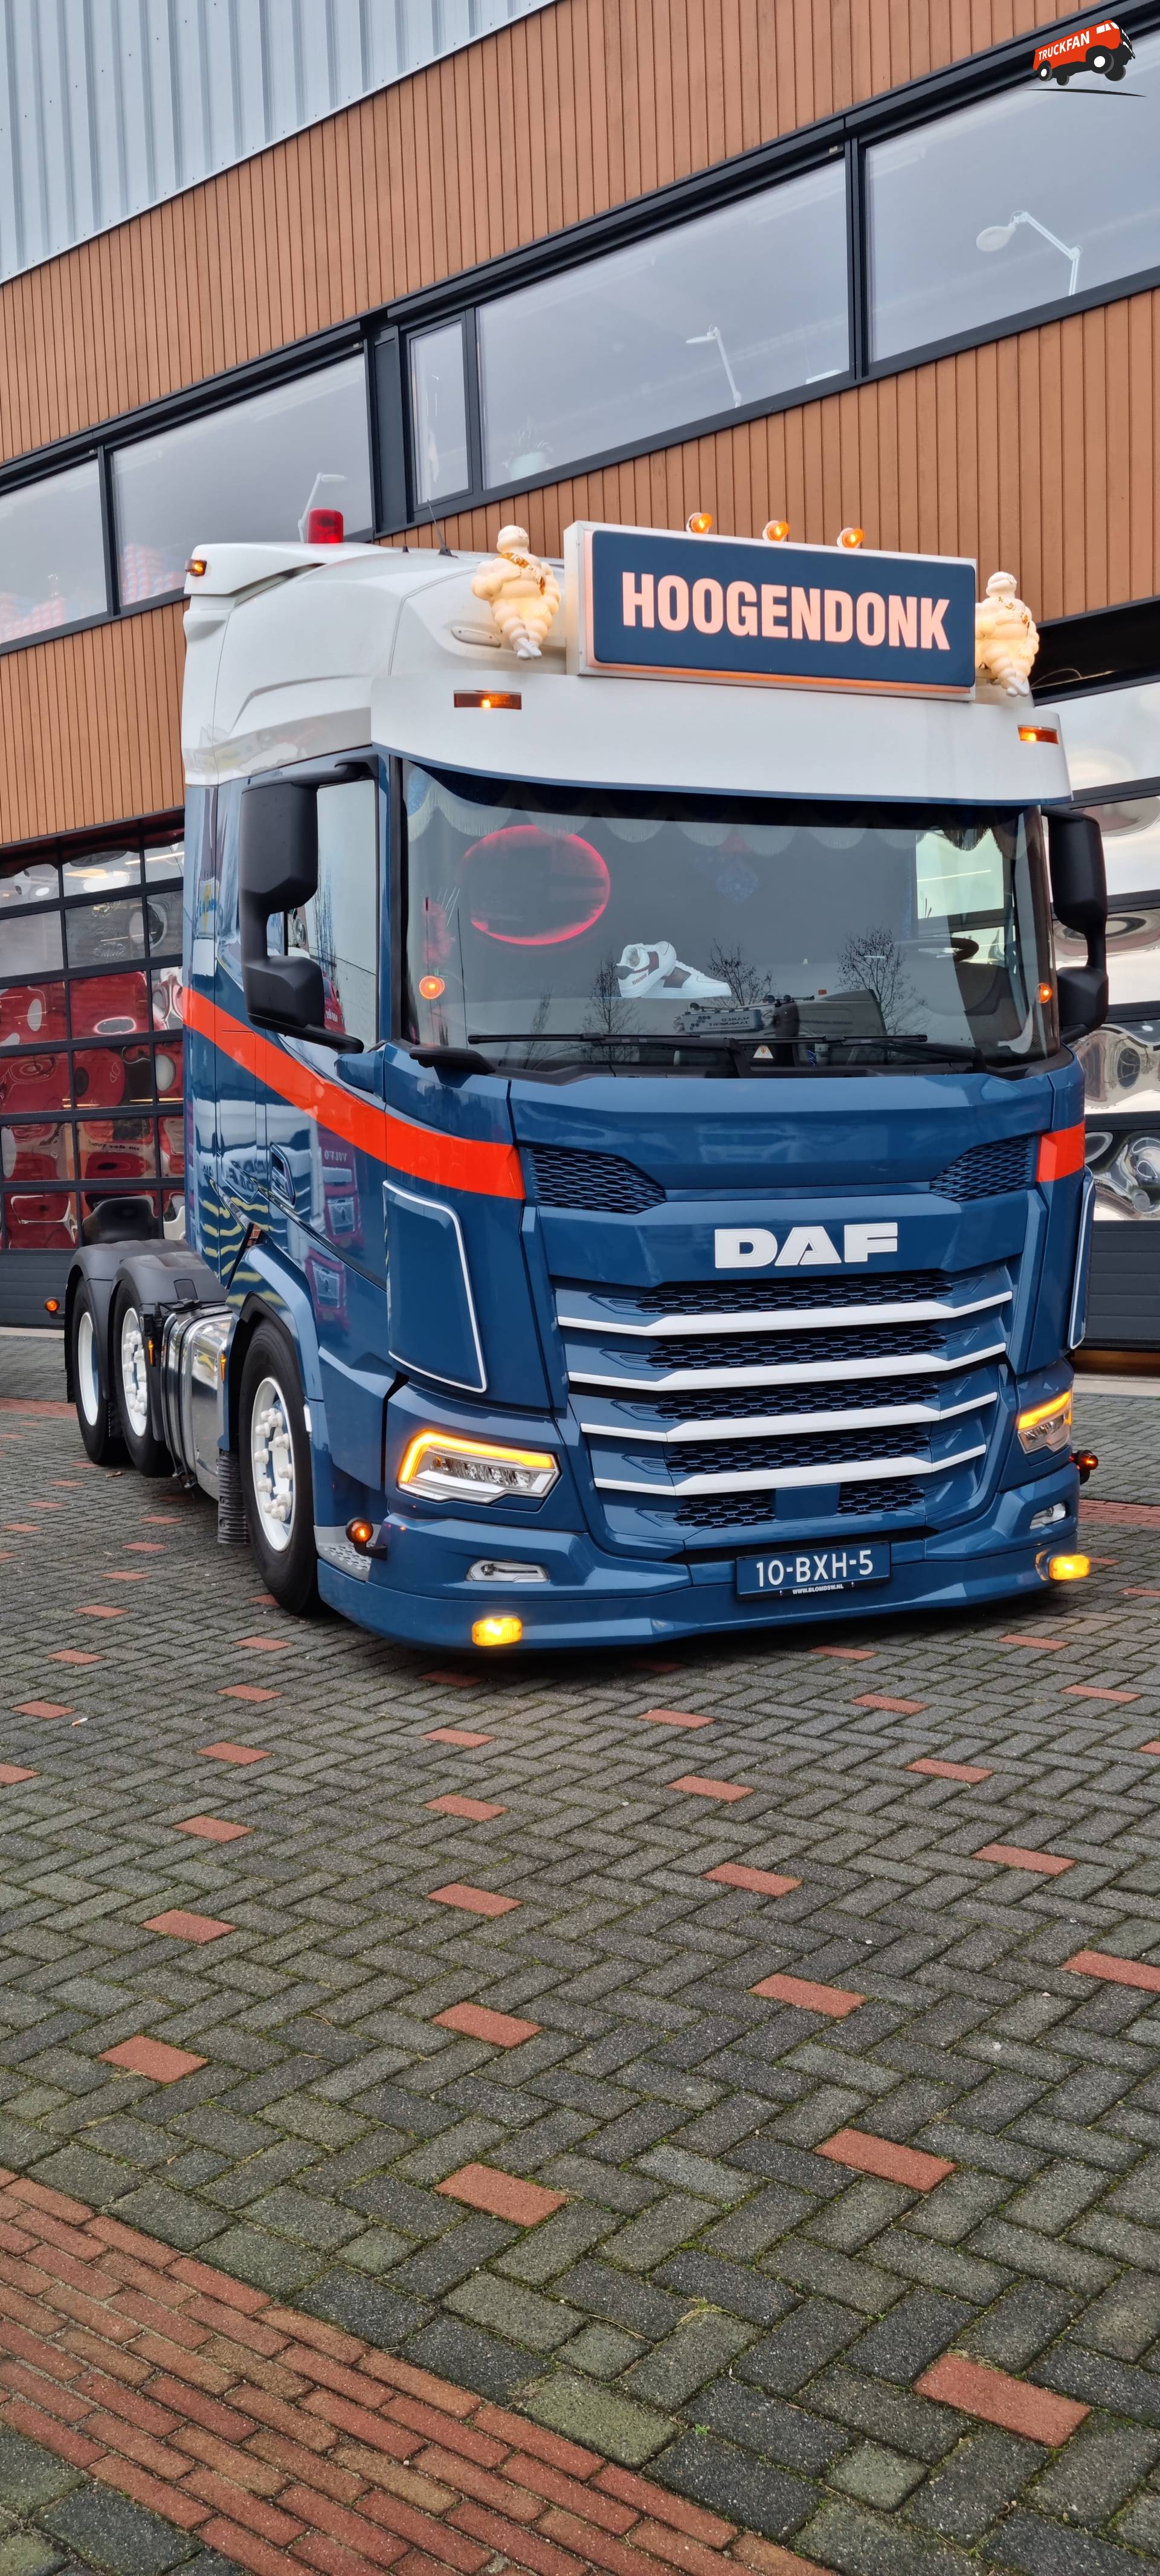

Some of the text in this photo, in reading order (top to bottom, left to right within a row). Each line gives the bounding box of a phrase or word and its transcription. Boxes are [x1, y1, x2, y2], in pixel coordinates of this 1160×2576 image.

[622, 572, 950, 650] HOOGENDONK
[714, 1222, 898, 1269] DAF
[756, 1550, 874, 1588] 10-BXH-5
